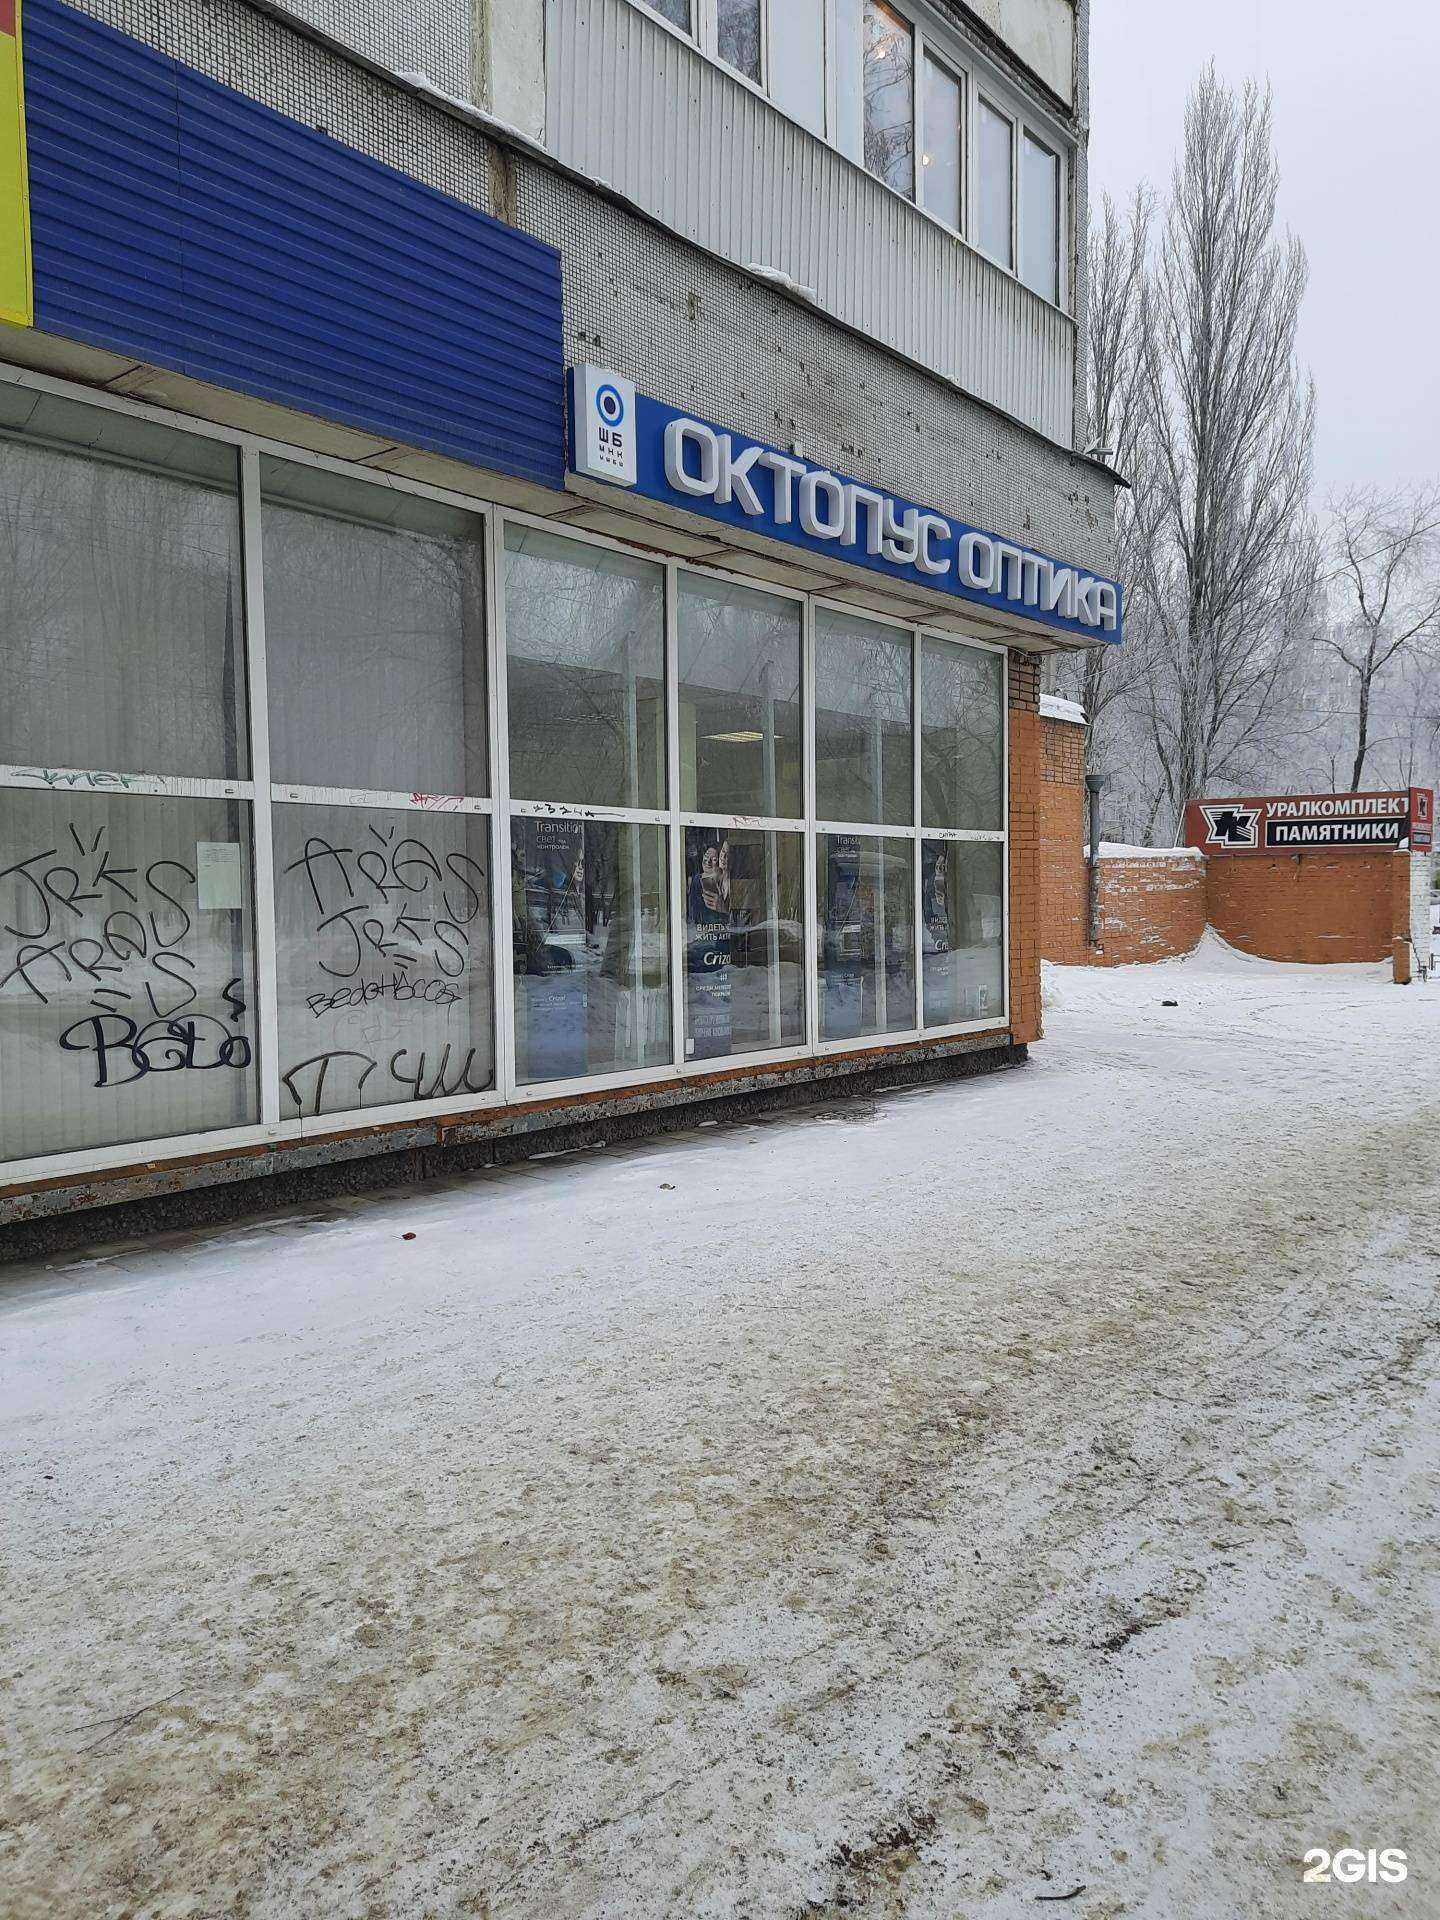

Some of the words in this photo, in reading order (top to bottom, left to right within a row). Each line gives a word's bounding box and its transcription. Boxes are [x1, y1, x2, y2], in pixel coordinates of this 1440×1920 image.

[664, 417, 951, 575] ОКТОПУС
[958, 531, 1117, 631] ОПТИКА
[1266, 797, 1409, 817] УРАЛКОМПЛЕКТ
[1275, 823, 1399, 842] ПАМЯТНИКИ
